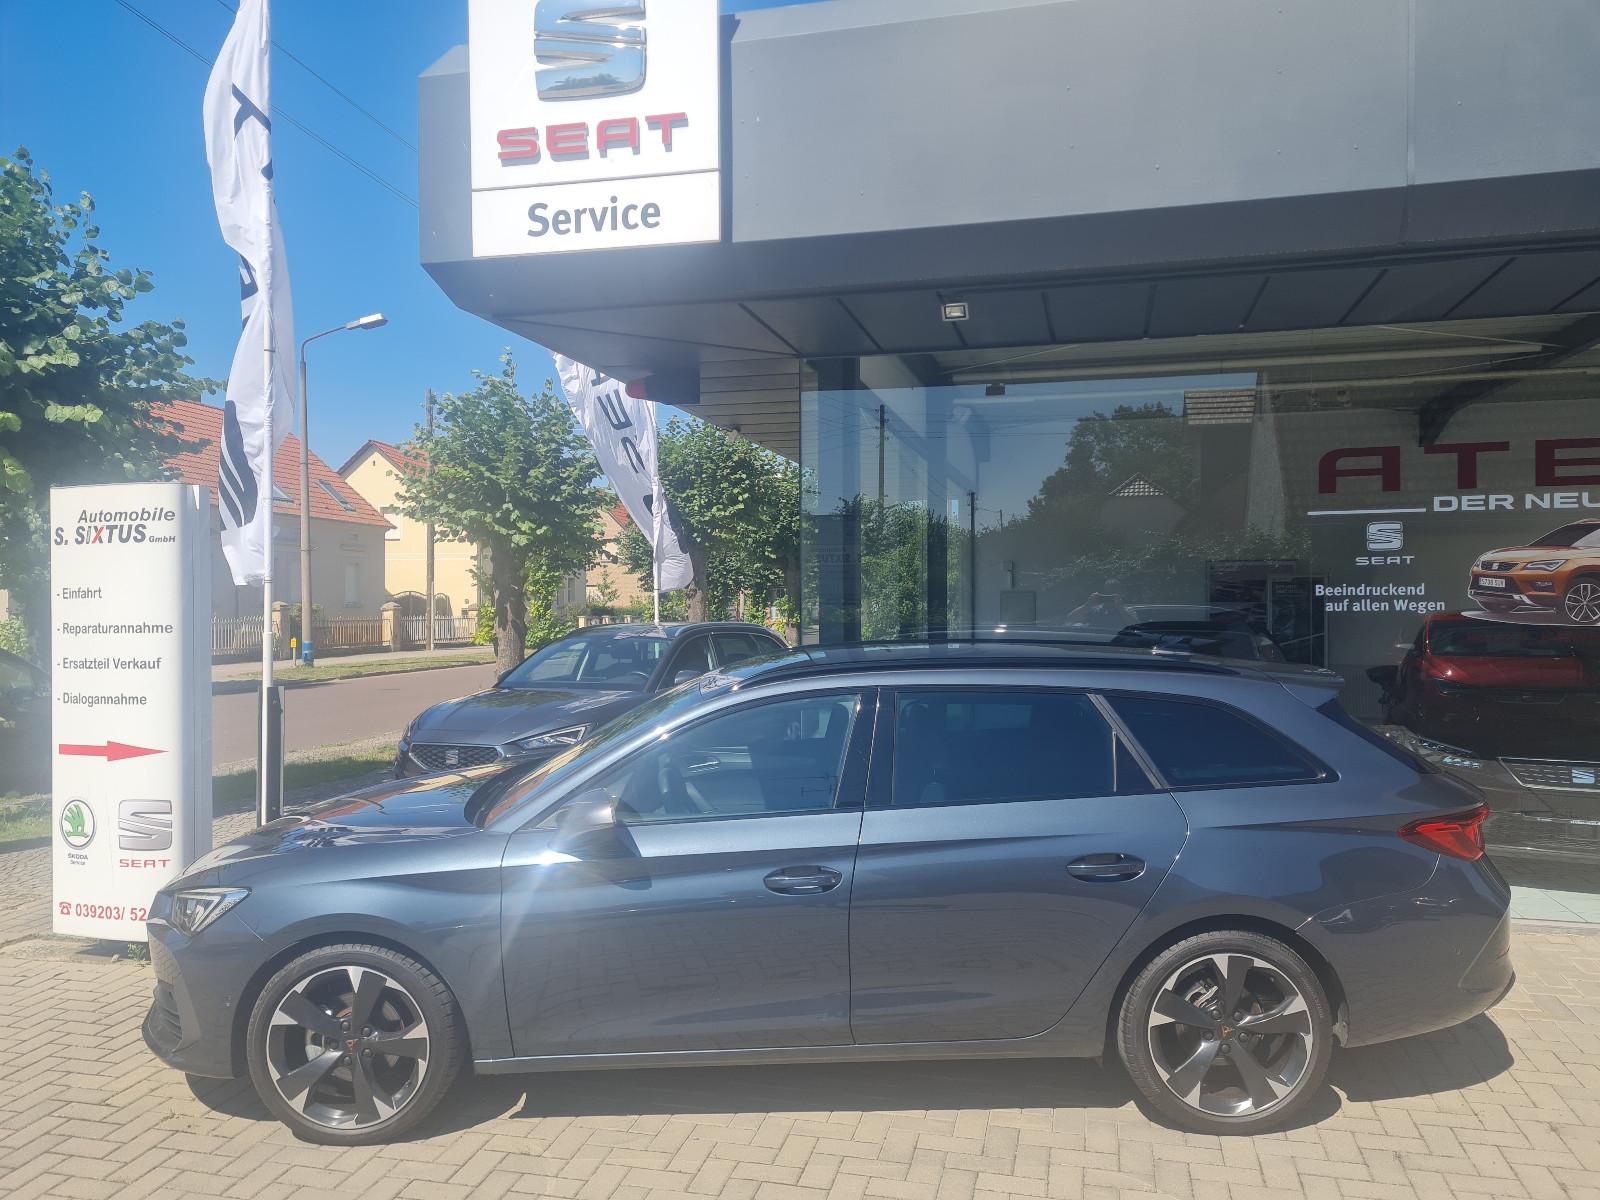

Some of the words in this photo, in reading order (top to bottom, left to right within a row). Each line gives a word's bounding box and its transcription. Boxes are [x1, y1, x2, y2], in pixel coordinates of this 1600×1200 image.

[497, 112, 688, 164] SEAT
[527, 196, 661, 237] Service
[1433, 494, 1514, 512] DER
[78, 507, 176, 523] Automobile
[54, 526, 69, 545] S.
[75, 523, 147, 545] SIXTUS
[148, 535, 176, 543] GmbH
[1355, 556, 1415, 566] SEAT
[62, 587, 102, 599] Einfahrt
[1315, 583, 1425, 596] Beeindruckend
[1325, 599, 1349, 612] auf
[1352, 599, 1389, 612] allen
[1393, 600, 1445, 614] Wegen
[62, 621, 174, 637] Reparaturannahme
[62, 658, 110, 670] Ersatzteil
[113, 657, 162, 670] Verkauf
[63, 692, 147, 707] Dialogannahme
[119, 858, 171, 868] SEAT
[75, 903, 125, 920] 039203/
